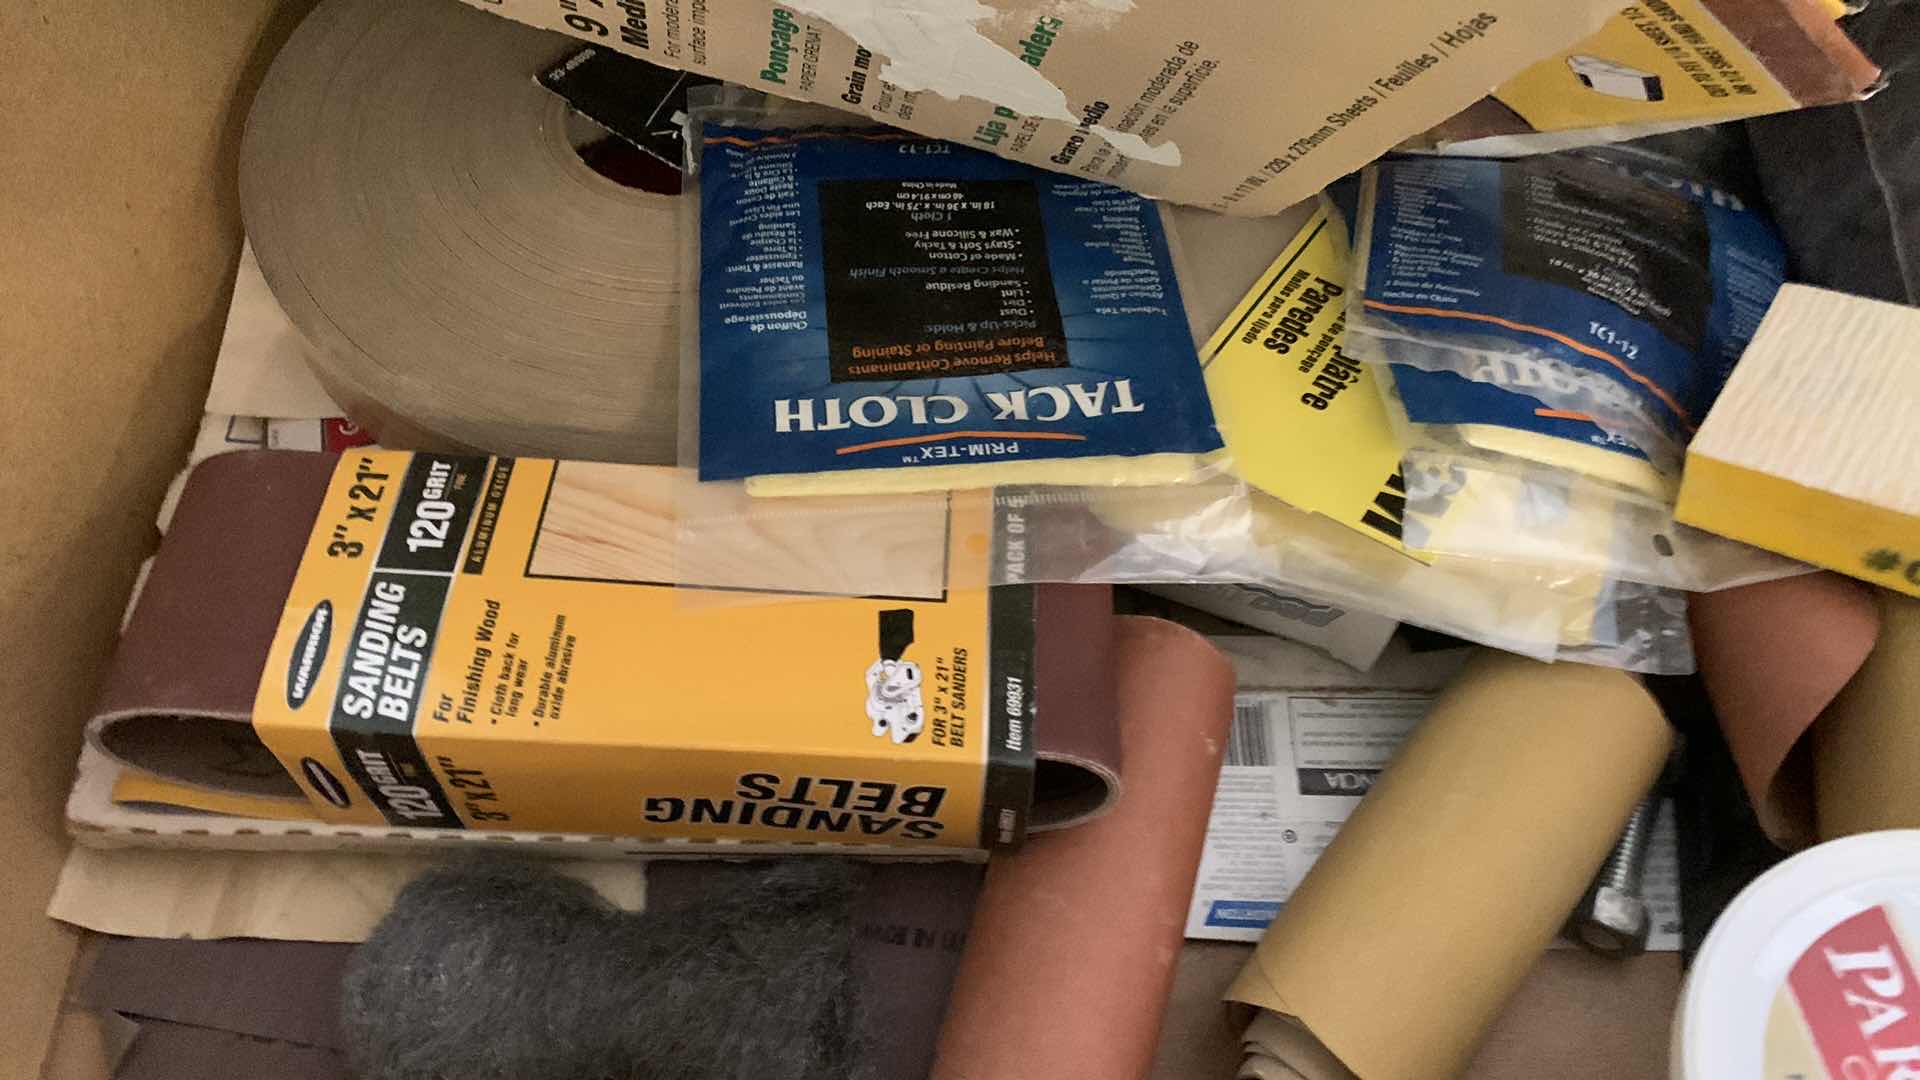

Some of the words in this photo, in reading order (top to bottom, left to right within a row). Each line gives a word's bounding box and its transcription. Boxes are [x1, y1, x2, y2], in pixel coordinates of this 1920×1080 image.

[664, 40, 681, 59] For
[687, 26, 707, 65] surface
[759, 8, 800, 85] Ponçage
[1140, 54, 1189, 103] moderada
[1175, 40, 1200, 57] de
[840, 70, 867, 105] Grain
[1288, 124, 1337, 156] 279mm
[1326, 93, 1379, 127] Sheets
[1374, 51, 1440, 92] Feuilles
[1437, 10, 1498, 49] Hojas
[973, 120, 1010, 146] Lija
[866, 201, 890, 210] Each
[948, 202, 960, 210] 36
[984, 201, 996, 209] 18
[911, 212, 944, 221] Cloth
[906, 231, 930, 239] Free
[932, 230, 977, 239] Silicone
[990, 228, 1014, 238] Wax
[915, 240, 946, 250] Tacky
[959, 242, 982, 250] Soft
[985, 239, 1015, 249] Stays
[762, 261, 803, 270] Ramasse
[930, 252, 968, 261] Cotton
[985, 253, 1017, 261] Made
[759, 276, 790, 284] Tacher
[791, 274, 804, 282] ou
[850, 267, 887, 278] Finish
[889, 267, 937, 276] Smooth
[725, 286, 762, 294] Peindre
[765, 284, 777, 293] de
[926, 282, 971, 291] Residue
[974, 278, 1022, 288] Sanding
[1001, 289, 1024, 297] Lint
[1280, 269, 1310, 297] Mallas
[724, 310, 807, 325] Dépoussiérage
[1000, 308, 1028, 317] Dust
[1262, 296, 1285, 319] para
[1263, 277, 1344, 355] Paredes
[750, 323, 764, 332] de
[767, 320, 808, 330] Chiffon
[968, 322, 978, 331] &
[980, 319, 1037, 330] Picks-Up
[1242, 318, 1270, 344] lijado
[916, 344, 931, 352] or
[935, 339, 994, 352] Painting
[998, 336, 1045, 348] Before
[1588, 318, 1639, 362] TC1-12
[853, 344, 913, 359] Staining
[954, 354, 1013, 366] Remove
[1015, 351, 1057, 362] Helps
[1298, 333, 1334, 373] ponçage
[848, 358, 951, 375] Contaminants
[996, 379, 1144, 421] TACK
[775, 394, 969, 433] CLOTH
[421, 460, 453, 501] GRIT
[326, 525, 364, 560] 3"
[347, 457, 390, 507] 21"
[405, 501, 457, 553] 120
[472, 500, 499, 564] ALUMINUM
[1006, 511, 1029, 532] OF
[1004, 533, 1028, 584] PACK
[342, 580, 407, 721] SANDING
[506, 633, 519, 648] for
[455, 644, 489, 725] Finishing
[474, 598, 501, 644] Wood
[498, 652, 514, 680] back
[532, 672, 552, 718] Durable
[545, 614, 566, 669] aluminum
[935, 656, 950, 682] 21"
[376, 625, 428, 722] BELTS
[550, 687, 564, 719] oxide
[557, 635, 576, 684] abrasive
[952, 647, 970, 713] SANDERS
[504, 691, 523, 717] long
[514, 659, 528, 687] wear
[432, 692, 460, 724] For
[490, 683, 507, 715] Cloth
[932, 694, 948, 714] 3"
[931, 715, 948, 749] FOR
[950, 715, 968, 750] BELT
[1004, 717, 1024, 752] Item
[356, 750, 399, 784] GRIT
[436, 756, 492, 789] 21"
[379, 785, 443, 819] 120
[736, 772, 948, 818] BELTS
[643, 795, 946, 840] SANDING
